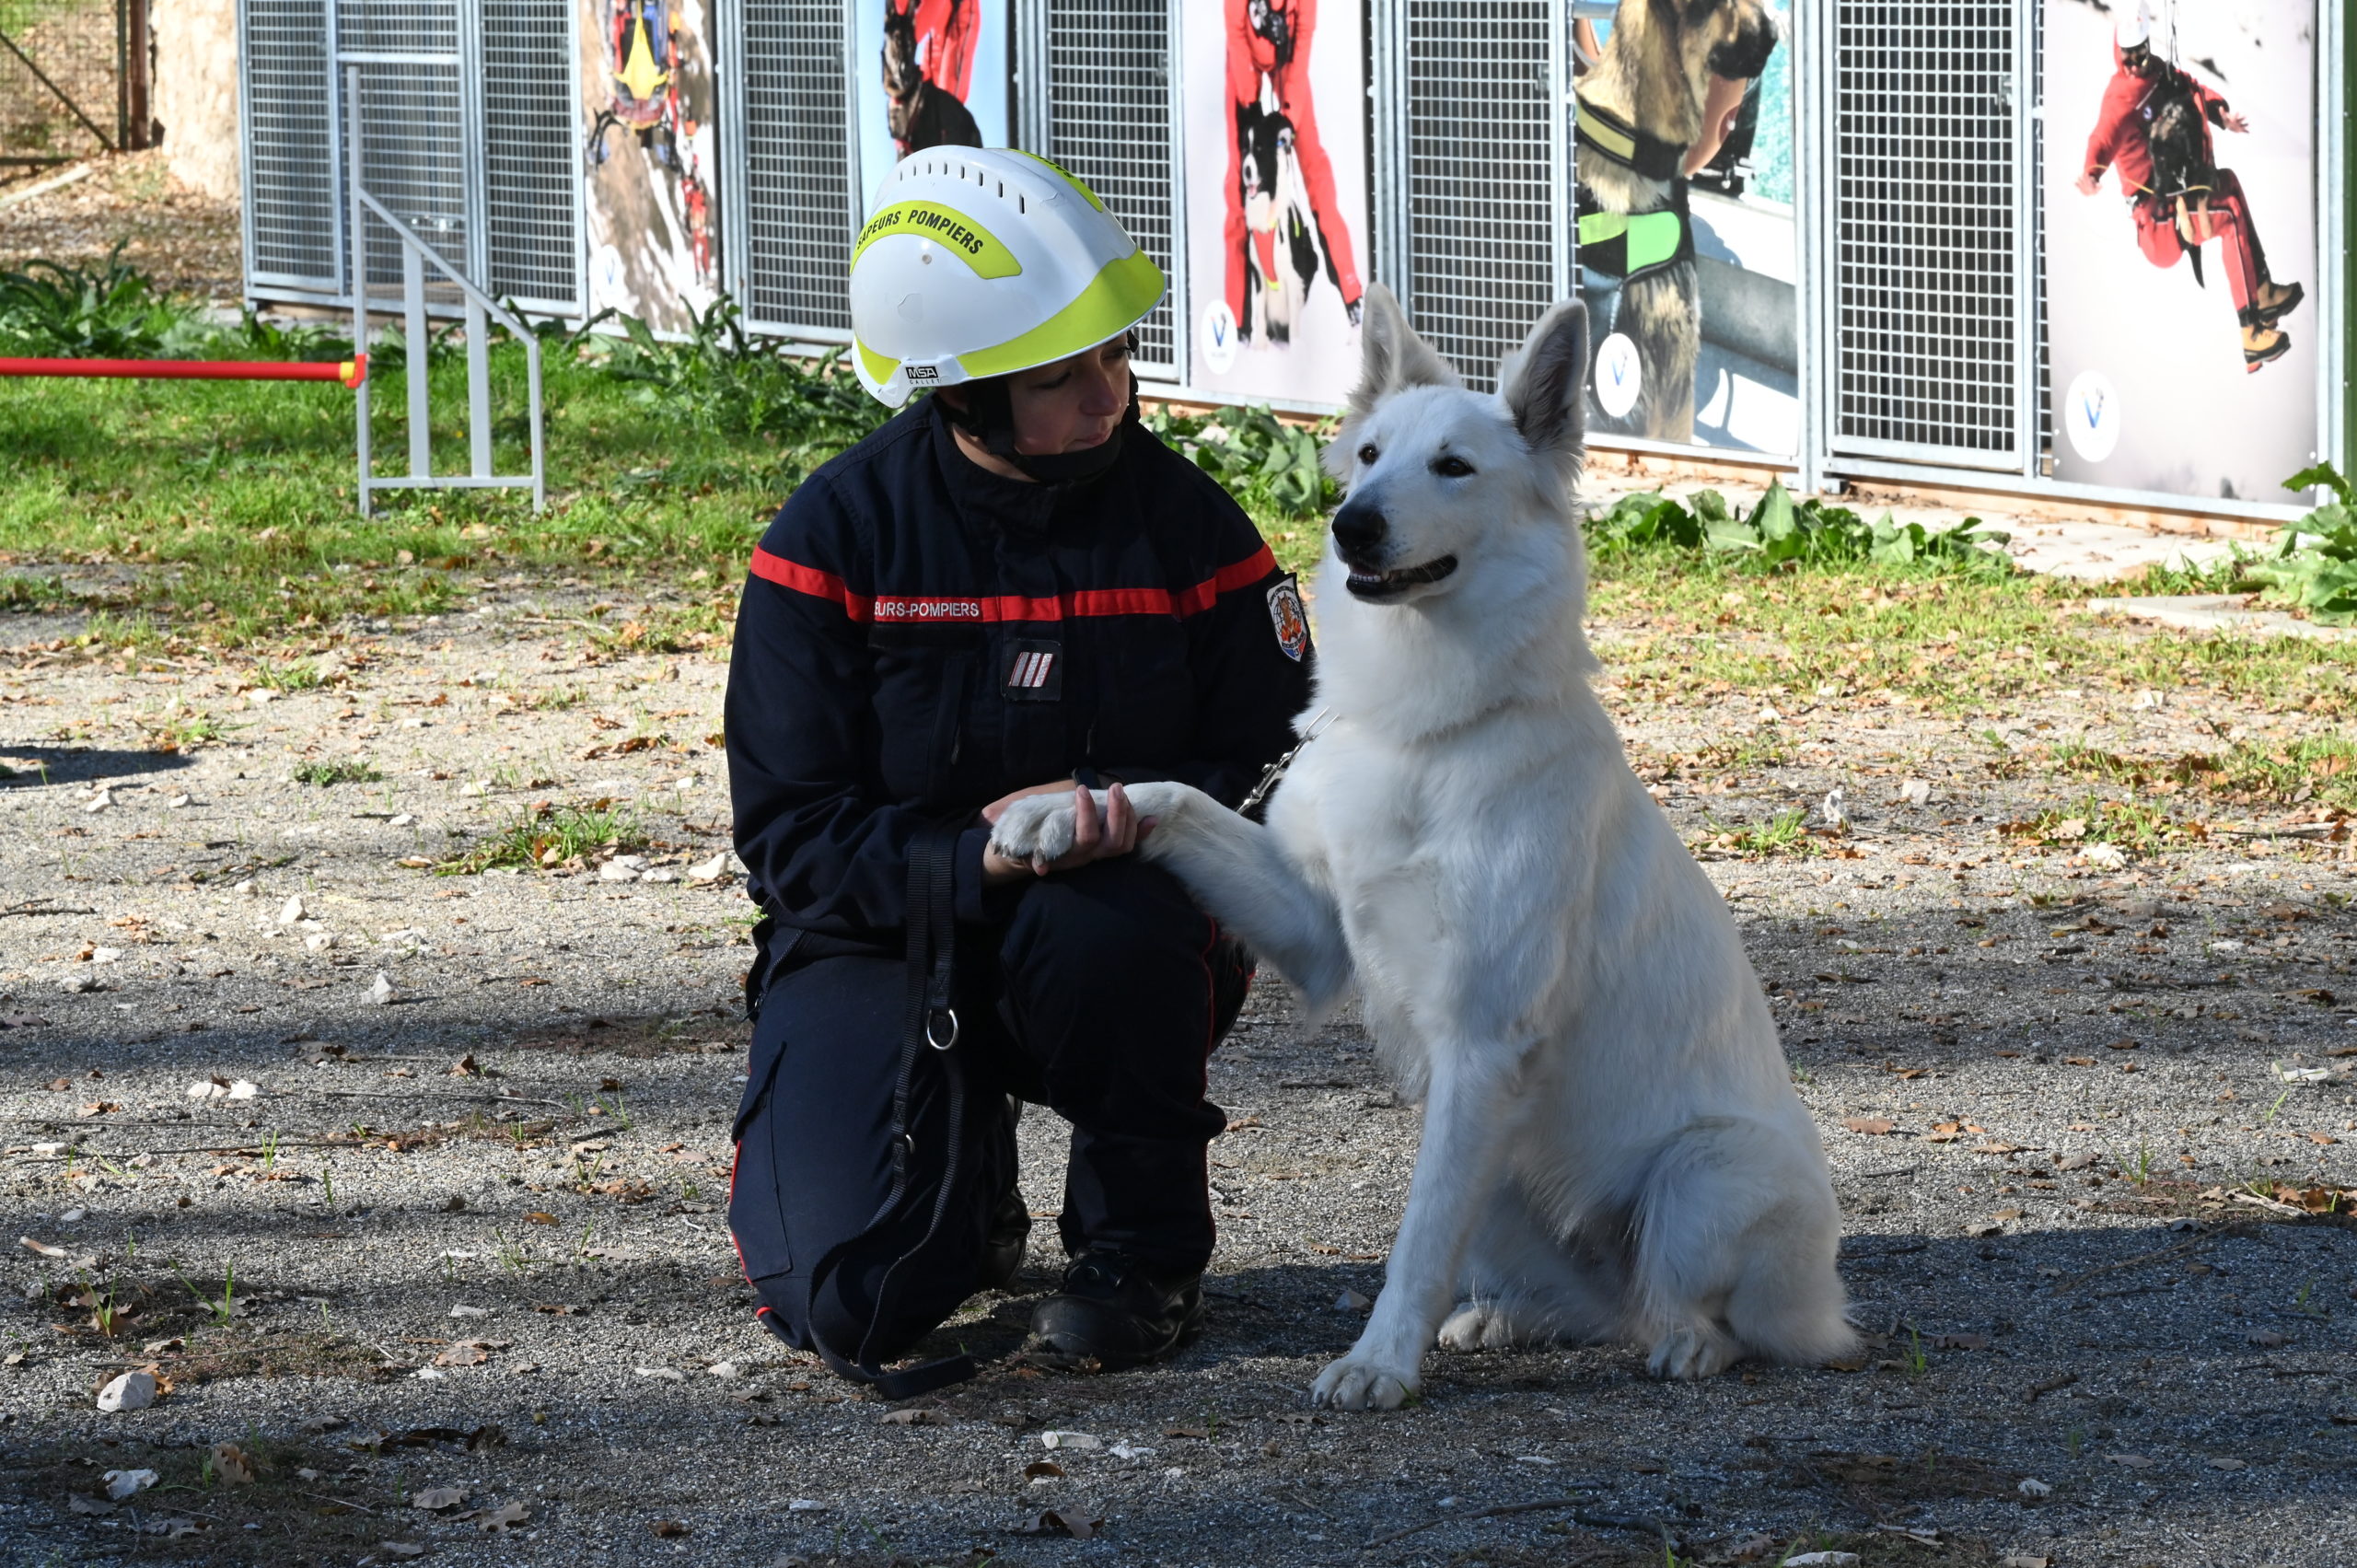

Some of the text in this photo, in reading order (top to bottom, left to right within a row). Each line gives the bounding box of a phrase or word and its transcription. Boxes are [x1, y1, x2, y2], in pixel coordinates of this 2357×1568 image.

[857, 209, 984, 254] SAPEURS POMPIERS
[907, 367, 937, 378] MSA
